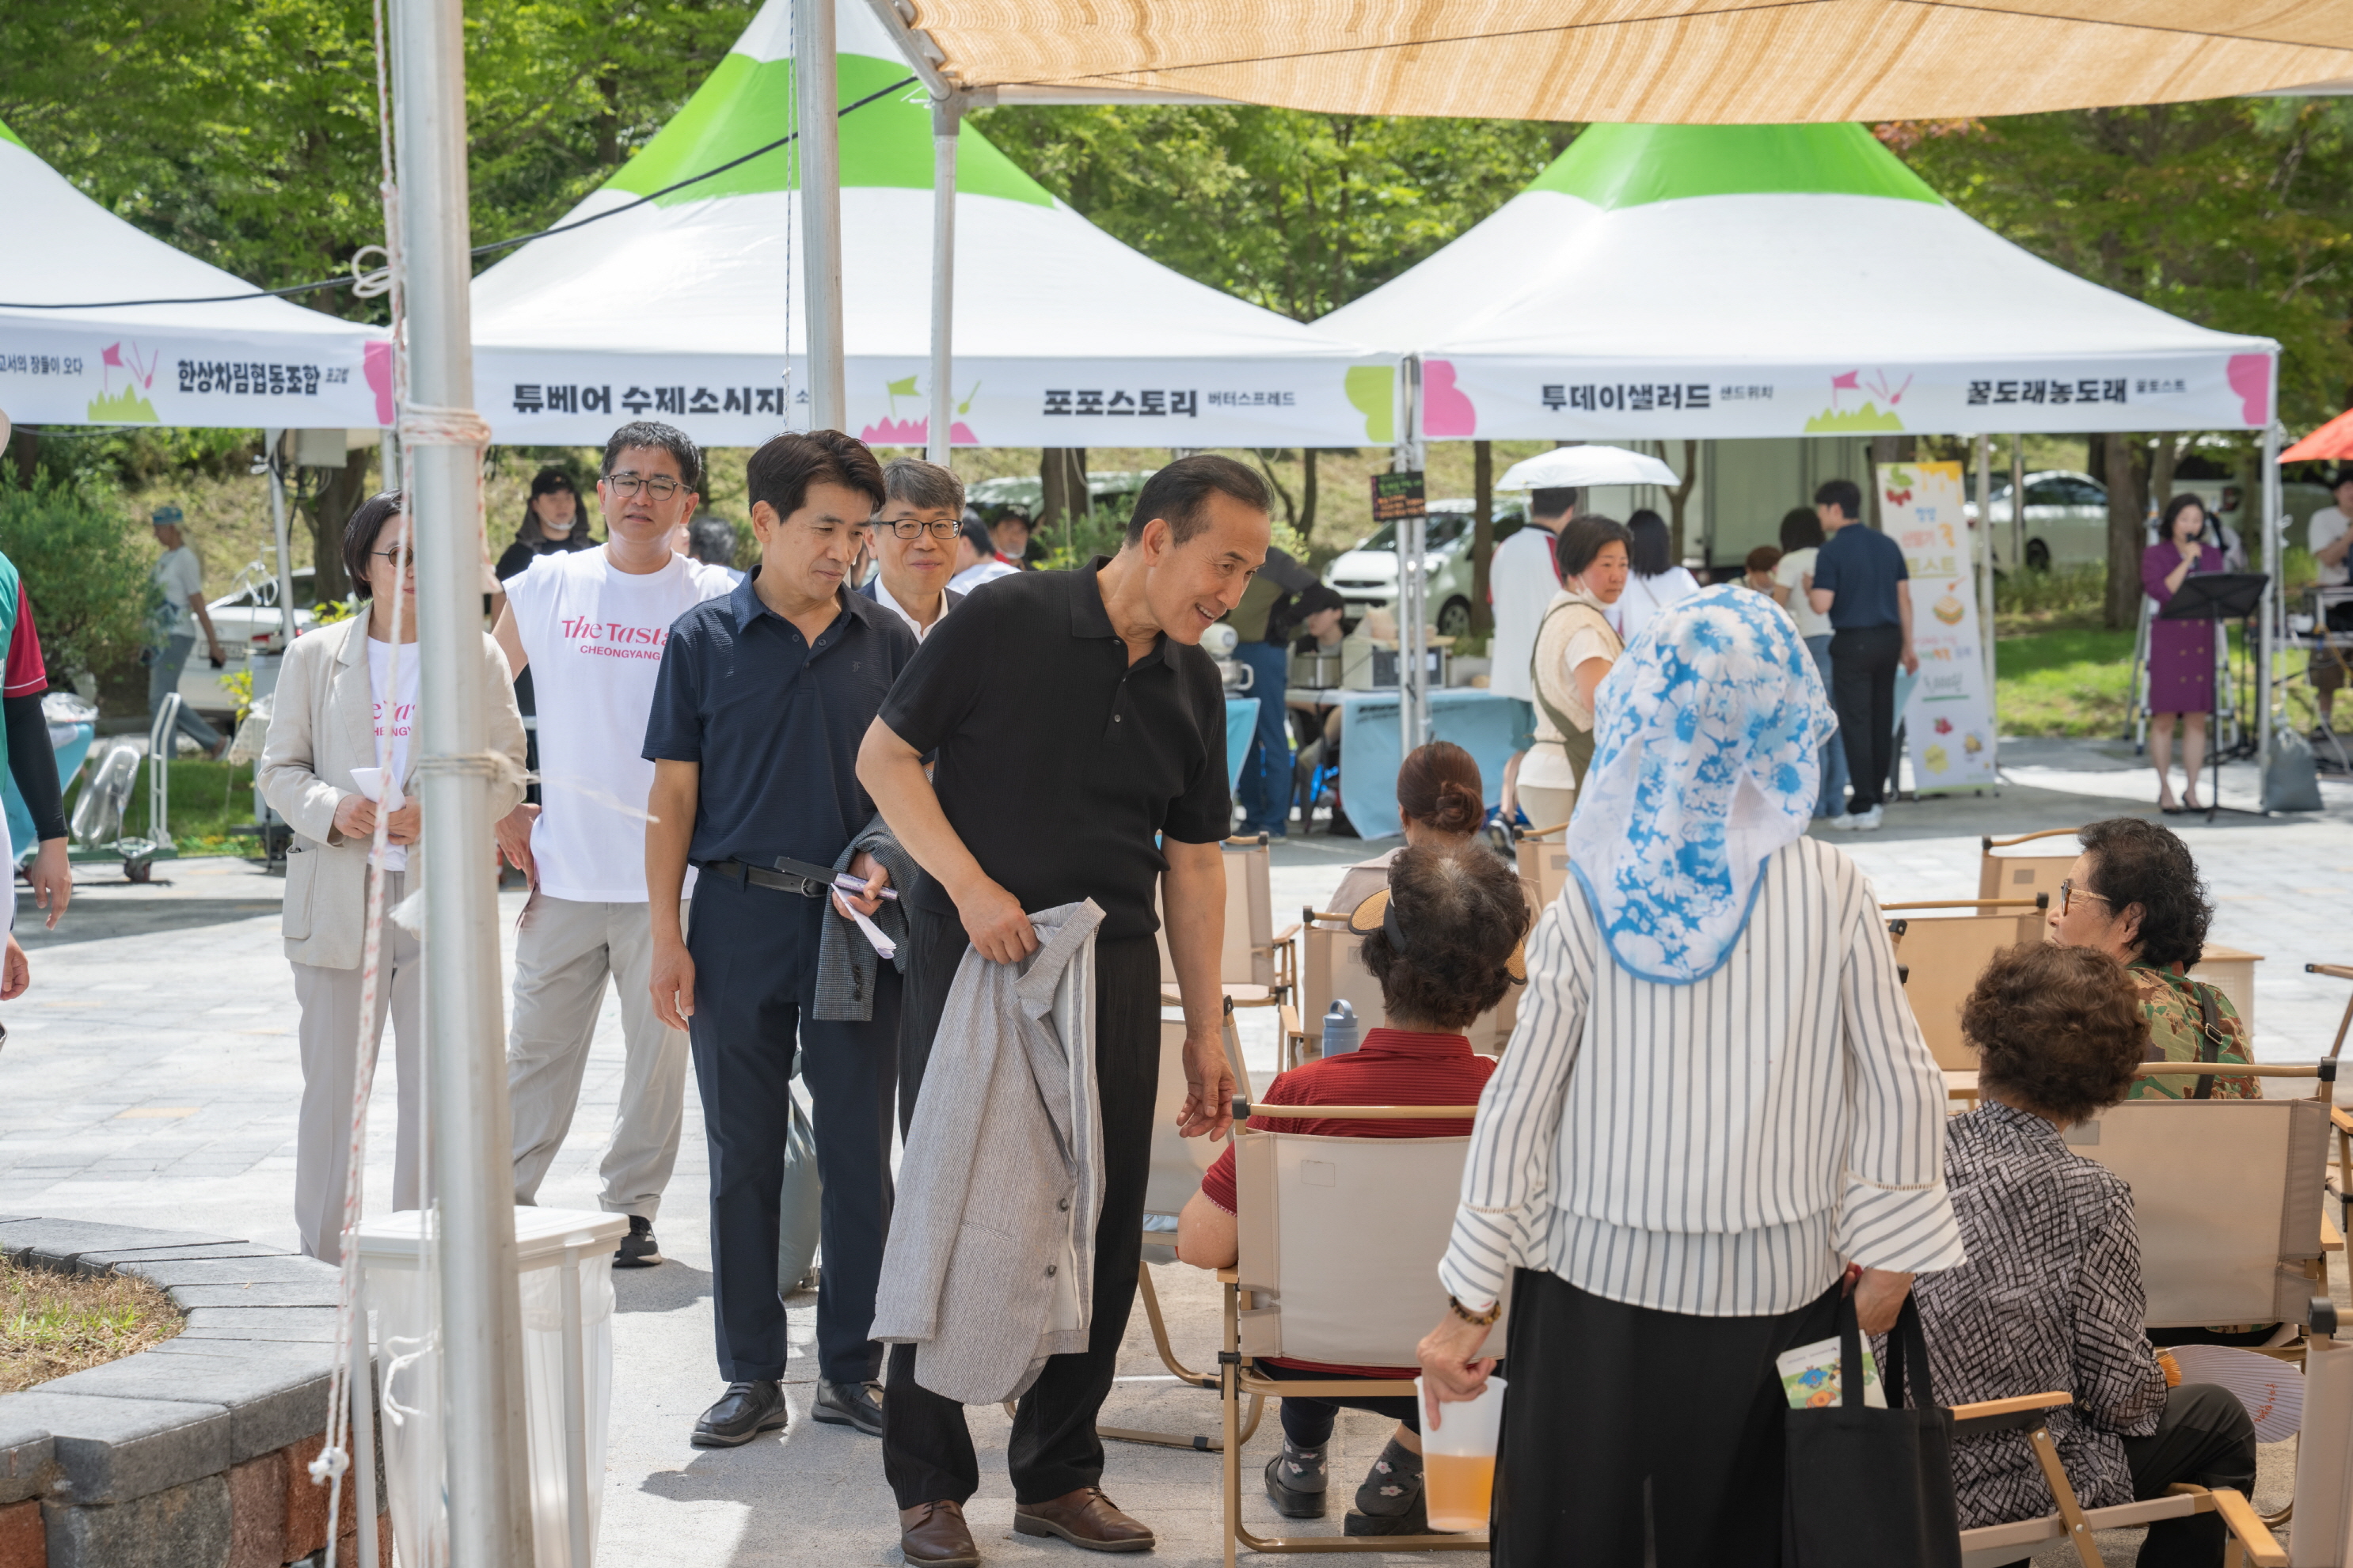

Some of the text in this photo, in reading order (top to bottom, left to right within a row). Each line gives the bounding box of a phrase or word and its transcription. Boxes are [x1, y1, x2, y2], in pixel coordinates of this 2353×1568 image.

[63, 355, 84, 376] 오다
[178, 359, 320, 395] 한상차림협동조합
[513, 385, 611, 414] 튜베어
[622, 385, 784, 415] 수제소시지
[1043, 390, 1296, 417] 포포스토리 버터스프레드
[1541, 384, 1710, 410] 투데이샐러드
[561, 616, 602, 639] The
[580, 645, 660, 661] CHEONGYANG
